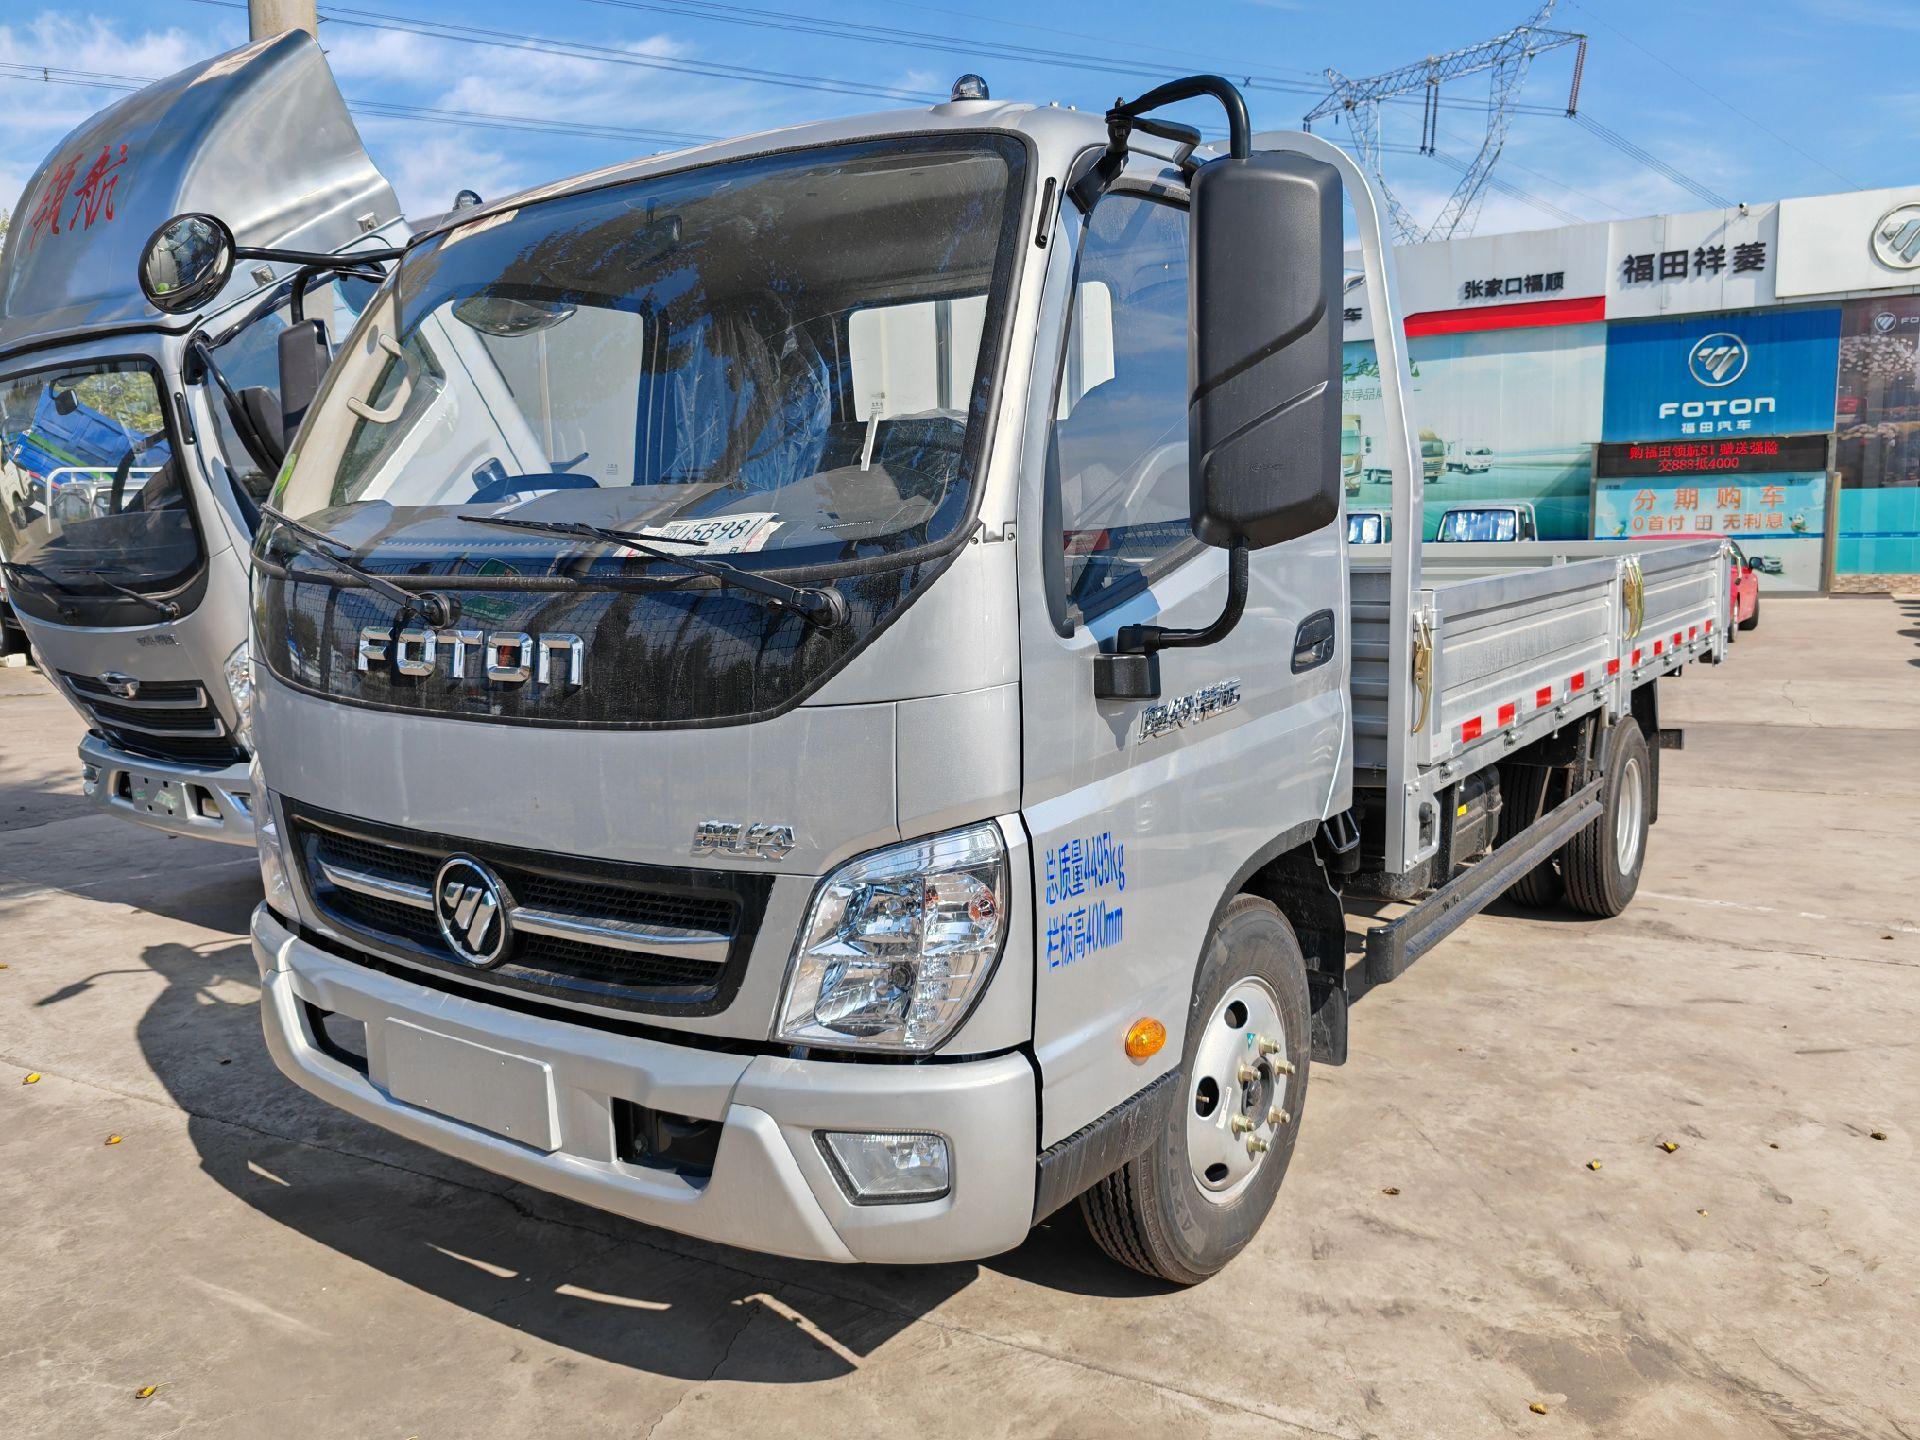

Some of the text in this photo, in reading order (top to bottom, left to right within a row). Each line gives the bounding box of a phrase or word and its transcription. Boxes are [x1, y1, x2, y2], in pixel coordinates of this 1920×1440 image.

[1623, 241, 1766, 283] 福田祥菱
[1465, 272, 1565, 299] 张家口福顺
[1659, 397, 1775, 419] FOTON
[1682, 420, 1751, 433] 福田汽车
[1633, 485, 1785, 512] 分期购车
[1723, 512, 1783, 530] 无利息
[358, 626, 585, 686] FOTON
[1045, 832, 1125, 905] 总质量4495kg
[1046, 900, 1123, 973] 栏板高400mm
